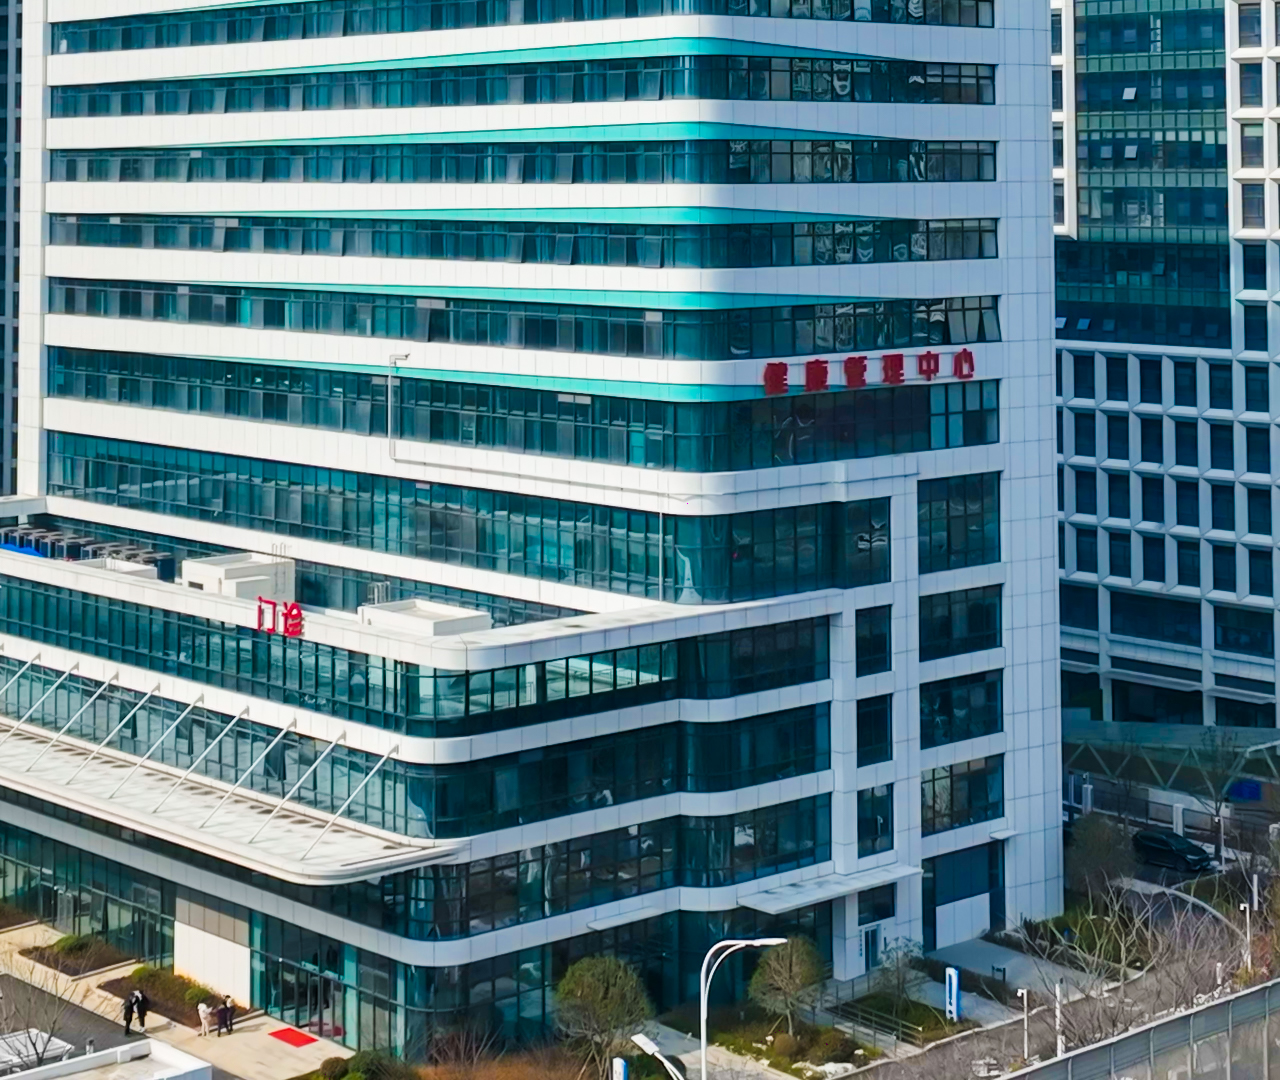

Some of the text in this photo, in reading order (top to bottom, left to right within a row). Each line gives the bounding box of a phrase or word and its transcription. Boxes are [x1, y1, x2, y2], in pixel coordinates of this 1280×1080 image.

[763, 348, 975, 396] 健康管理中心
[258, 596, 302, 638] 门诊
